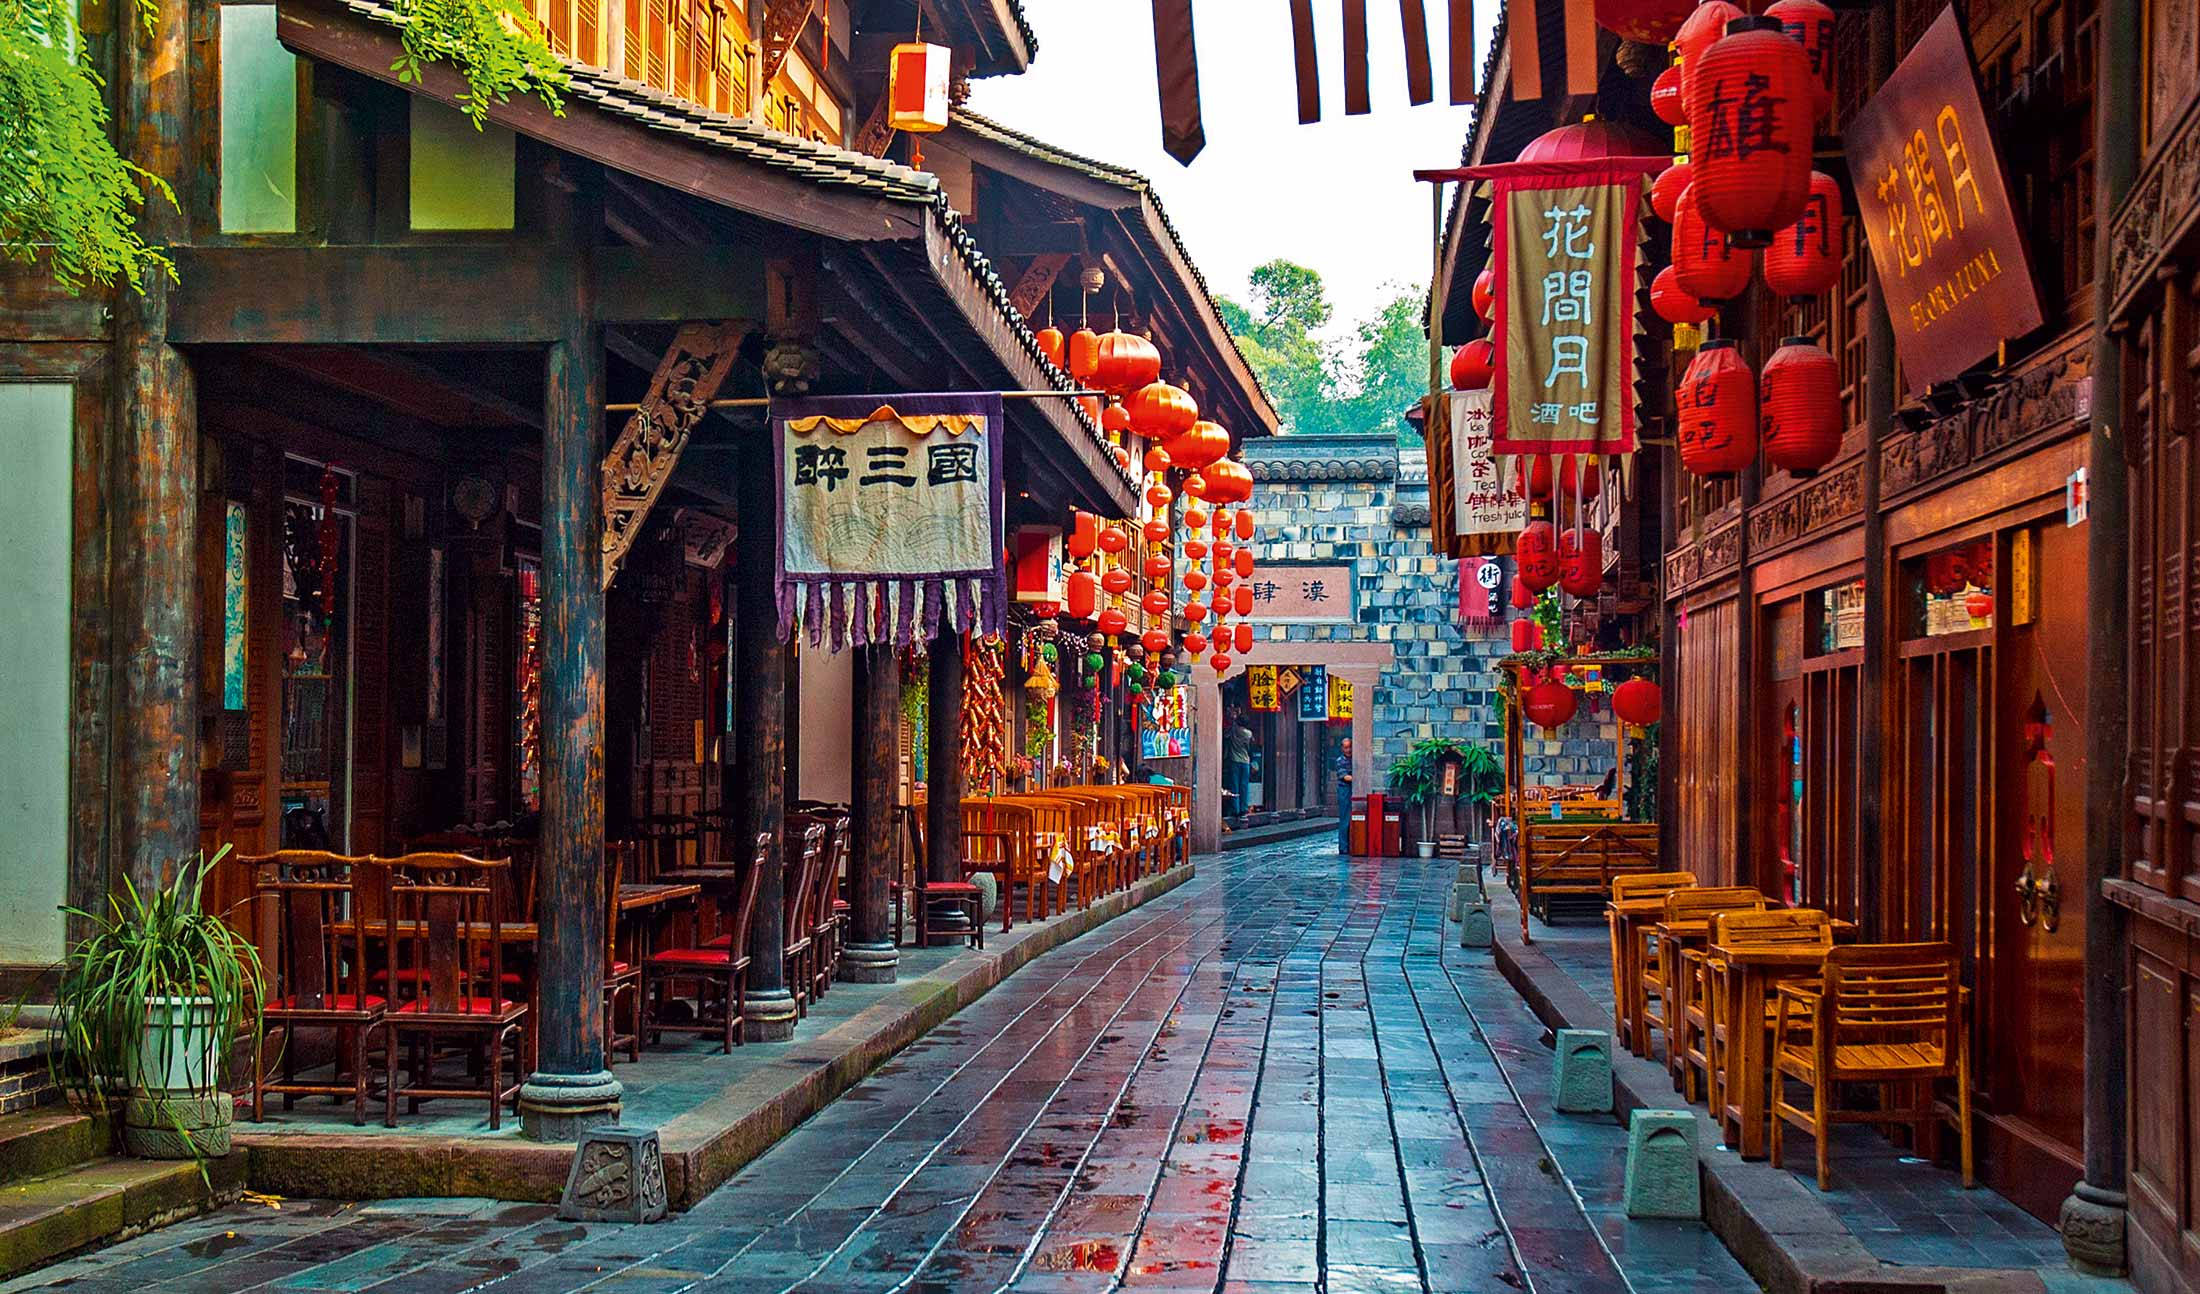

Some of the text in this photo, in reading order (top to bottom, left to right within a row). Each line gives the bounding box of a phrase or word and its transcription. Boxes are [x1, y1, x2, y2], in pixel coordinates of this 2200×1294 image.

[1541, 204, 1595, 389] 花間月
[1530, 402, 1600, 426] 酒吧
[795, 443, 979, 492] 醉三國
[1473, 481, 1496, 491] Tea
[1472, 511, 1502, 525] fresh
[1480, 566, 1500, 586] 街
